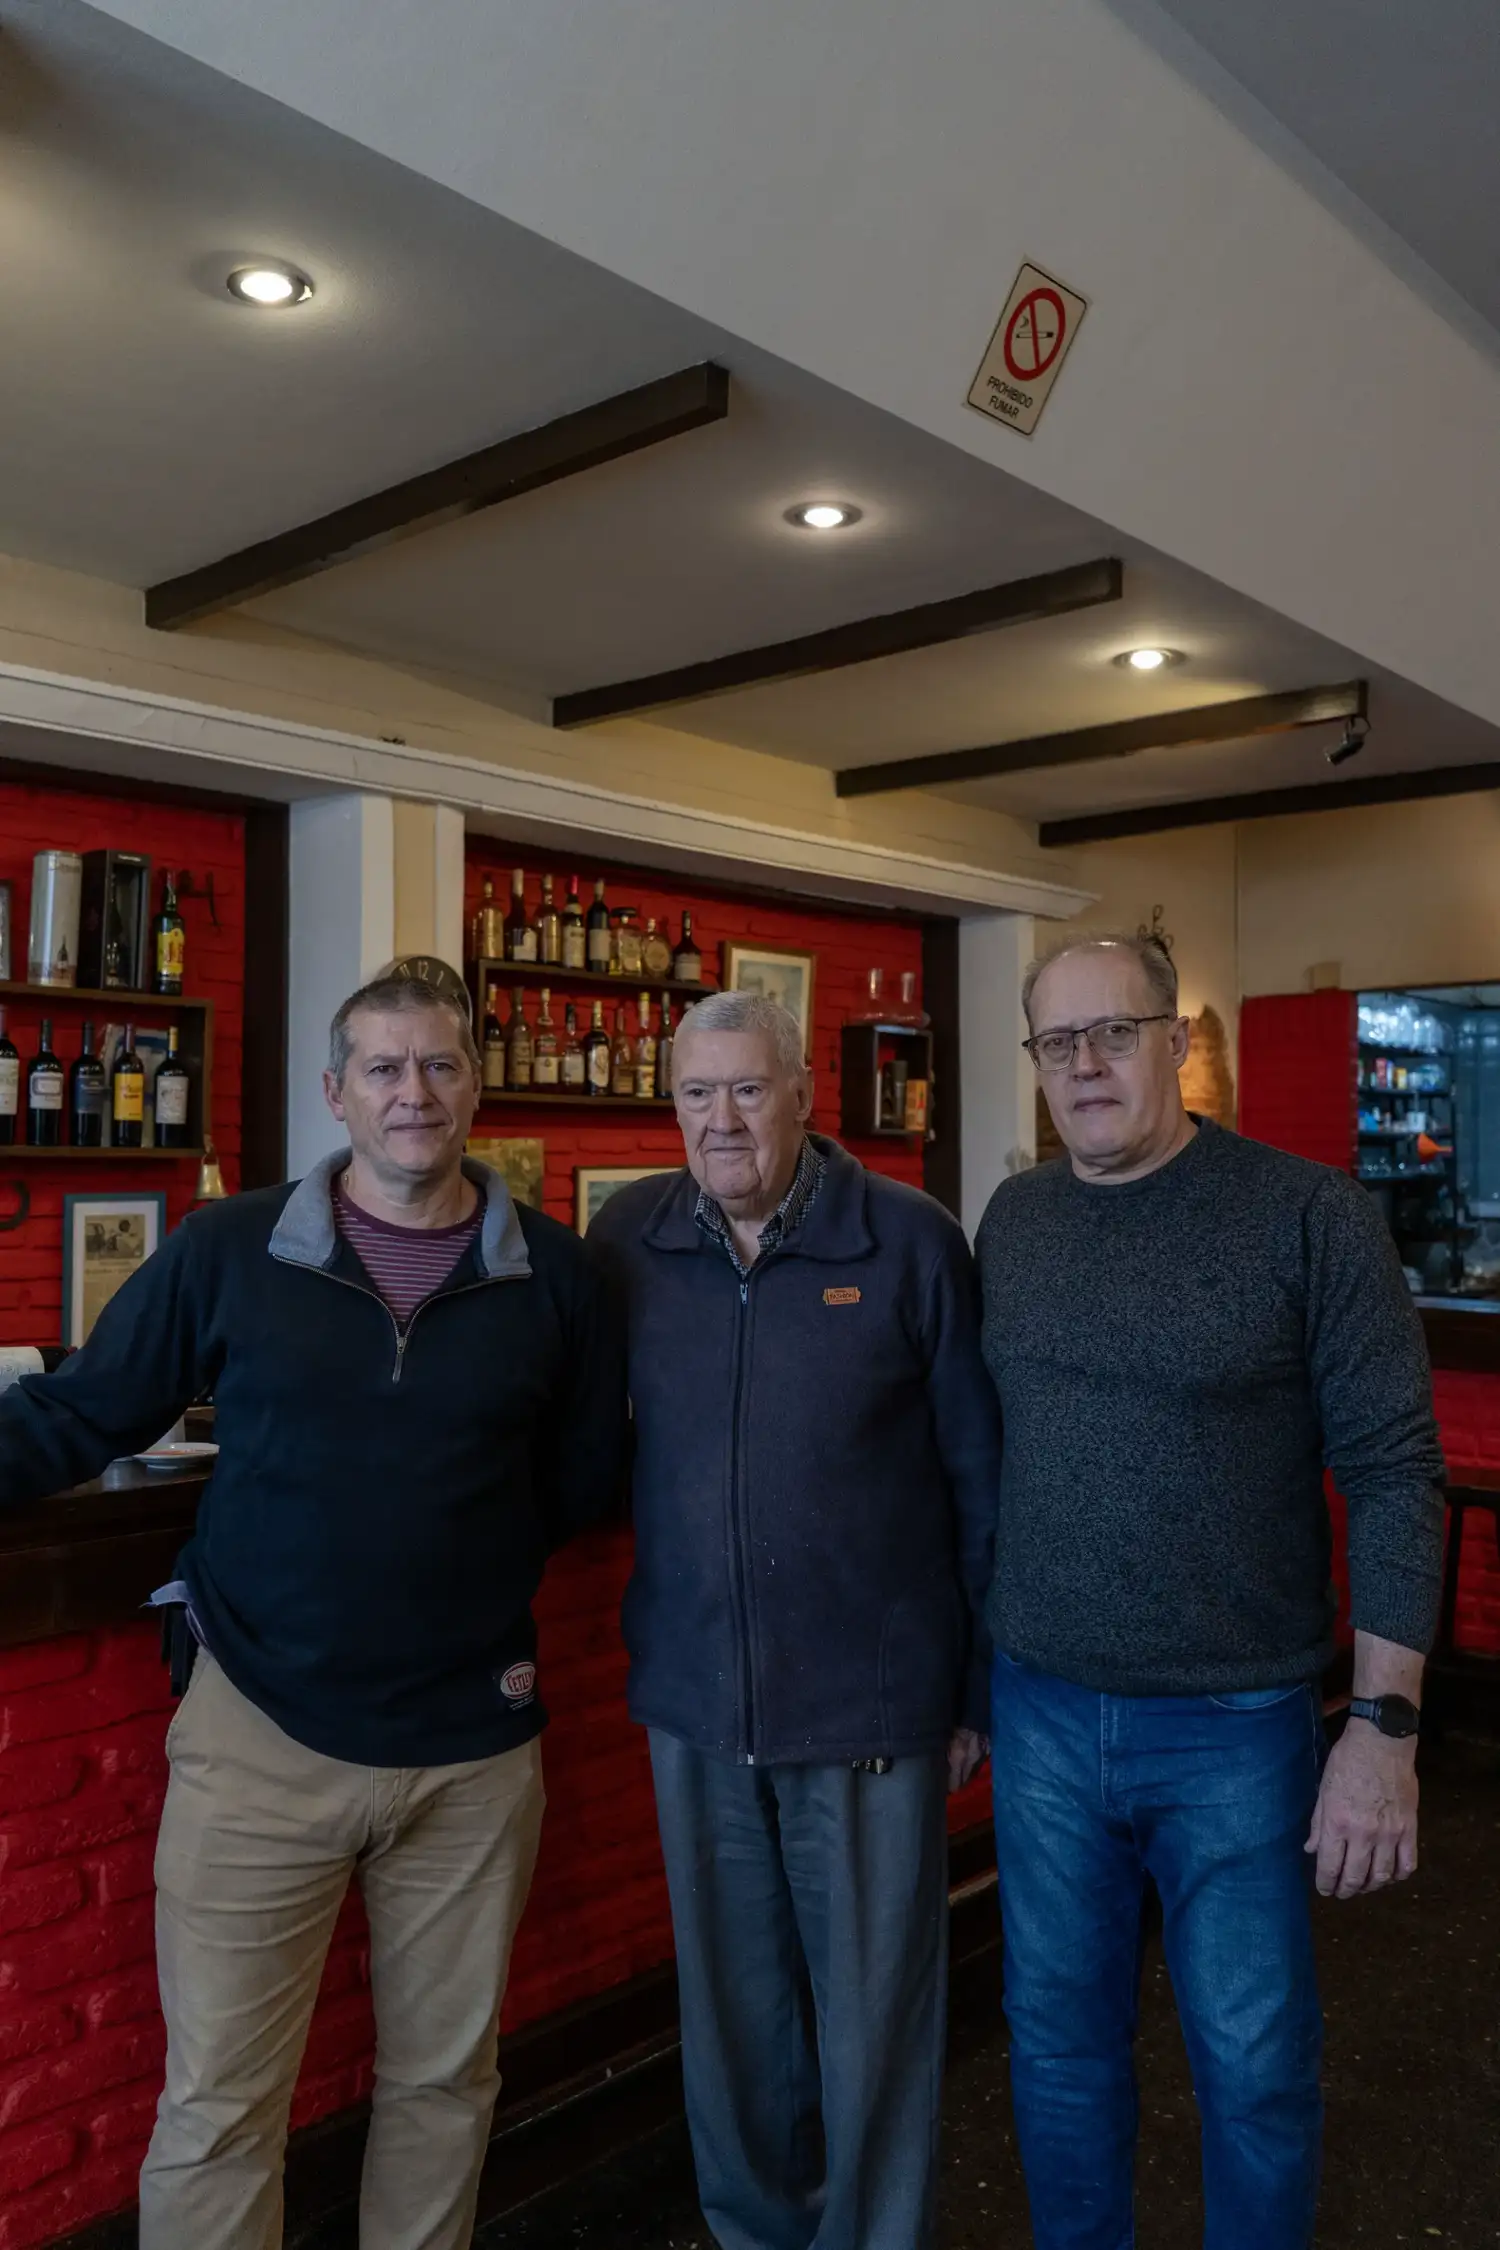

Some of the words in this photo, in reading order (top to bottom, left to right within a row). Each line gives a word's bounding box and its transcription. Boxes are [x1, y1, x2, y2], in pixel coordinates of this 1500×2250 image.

[986, 376, 1033, 409] PROHIBIDO
[988, 395, 1019, 419] FUMAR
[418, 960, 429, 981] 12
[437, 971, 444, 986] 1
